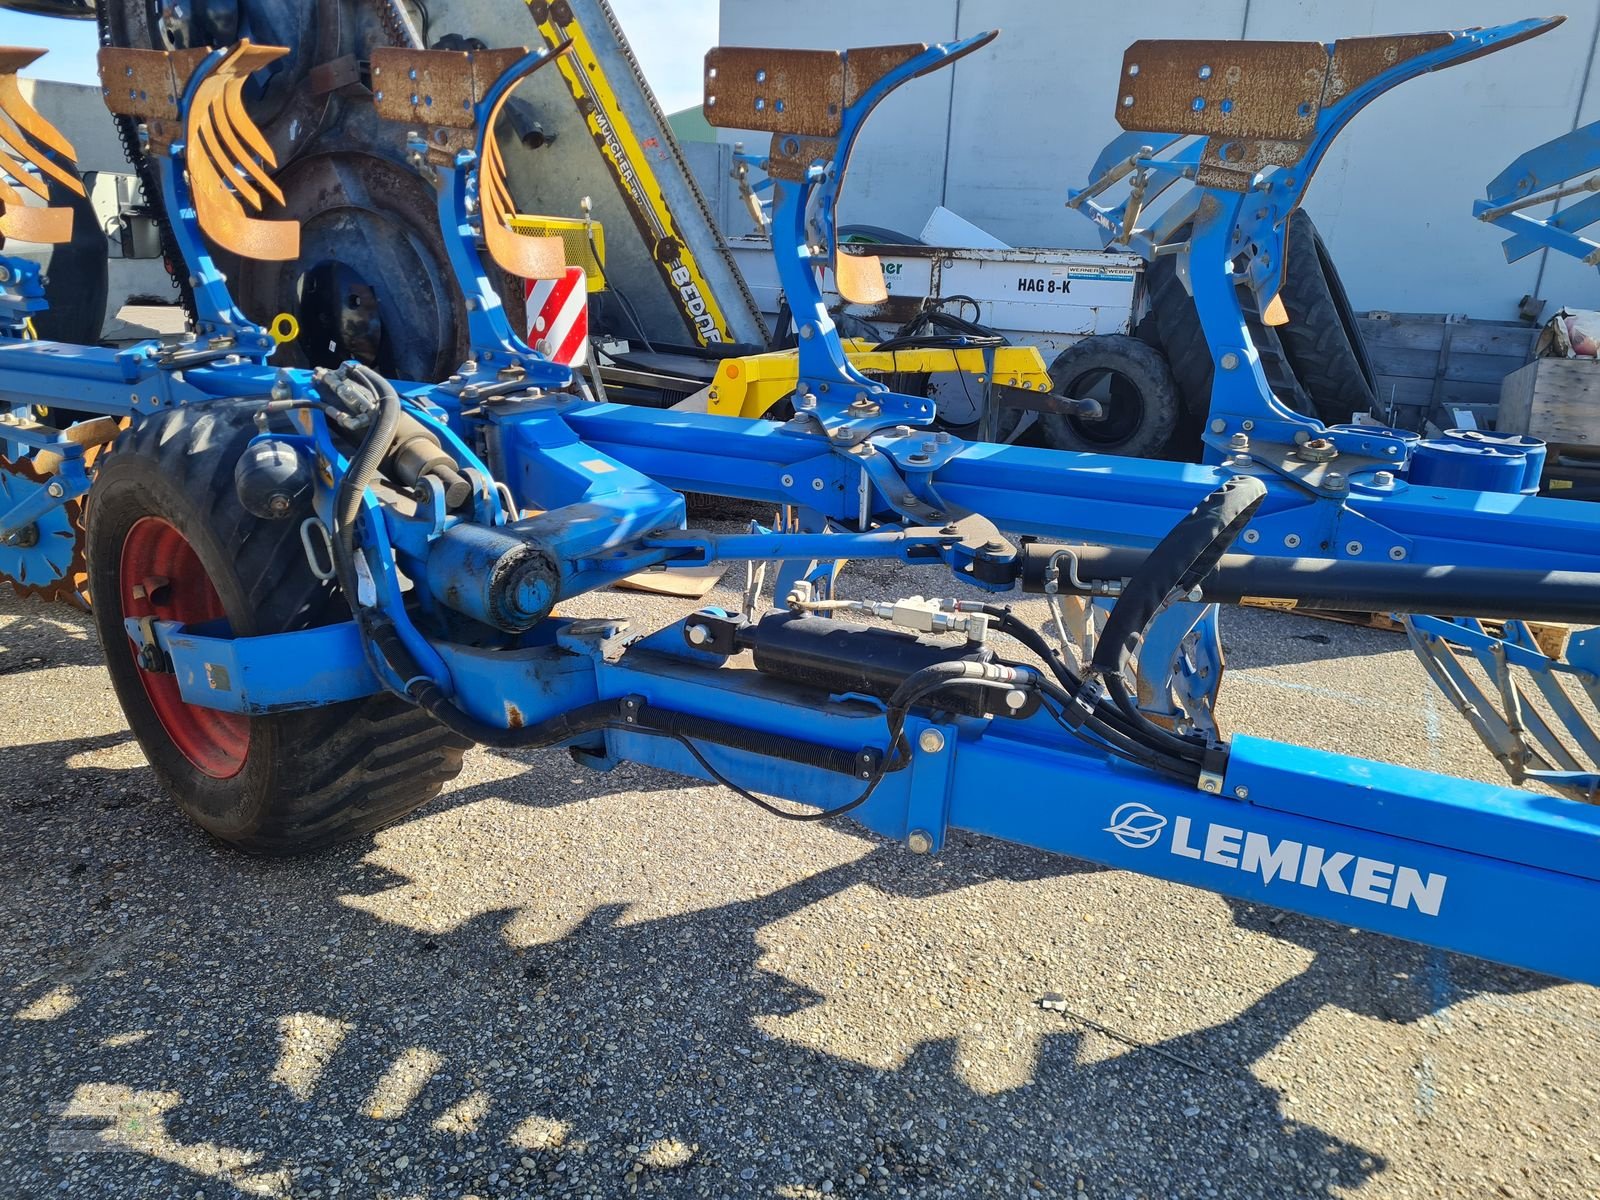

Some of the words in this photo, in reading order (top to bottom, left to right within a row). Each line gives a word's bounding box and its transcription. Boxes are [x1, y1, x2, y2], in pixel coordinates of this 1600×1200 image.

[880, 262, 903, 275] ner
[1017, 278, 1045, 293] HAG
[1047, 280, 1071, 294] 8-K
[1170, 815, 1447, 917] LEMKEN
